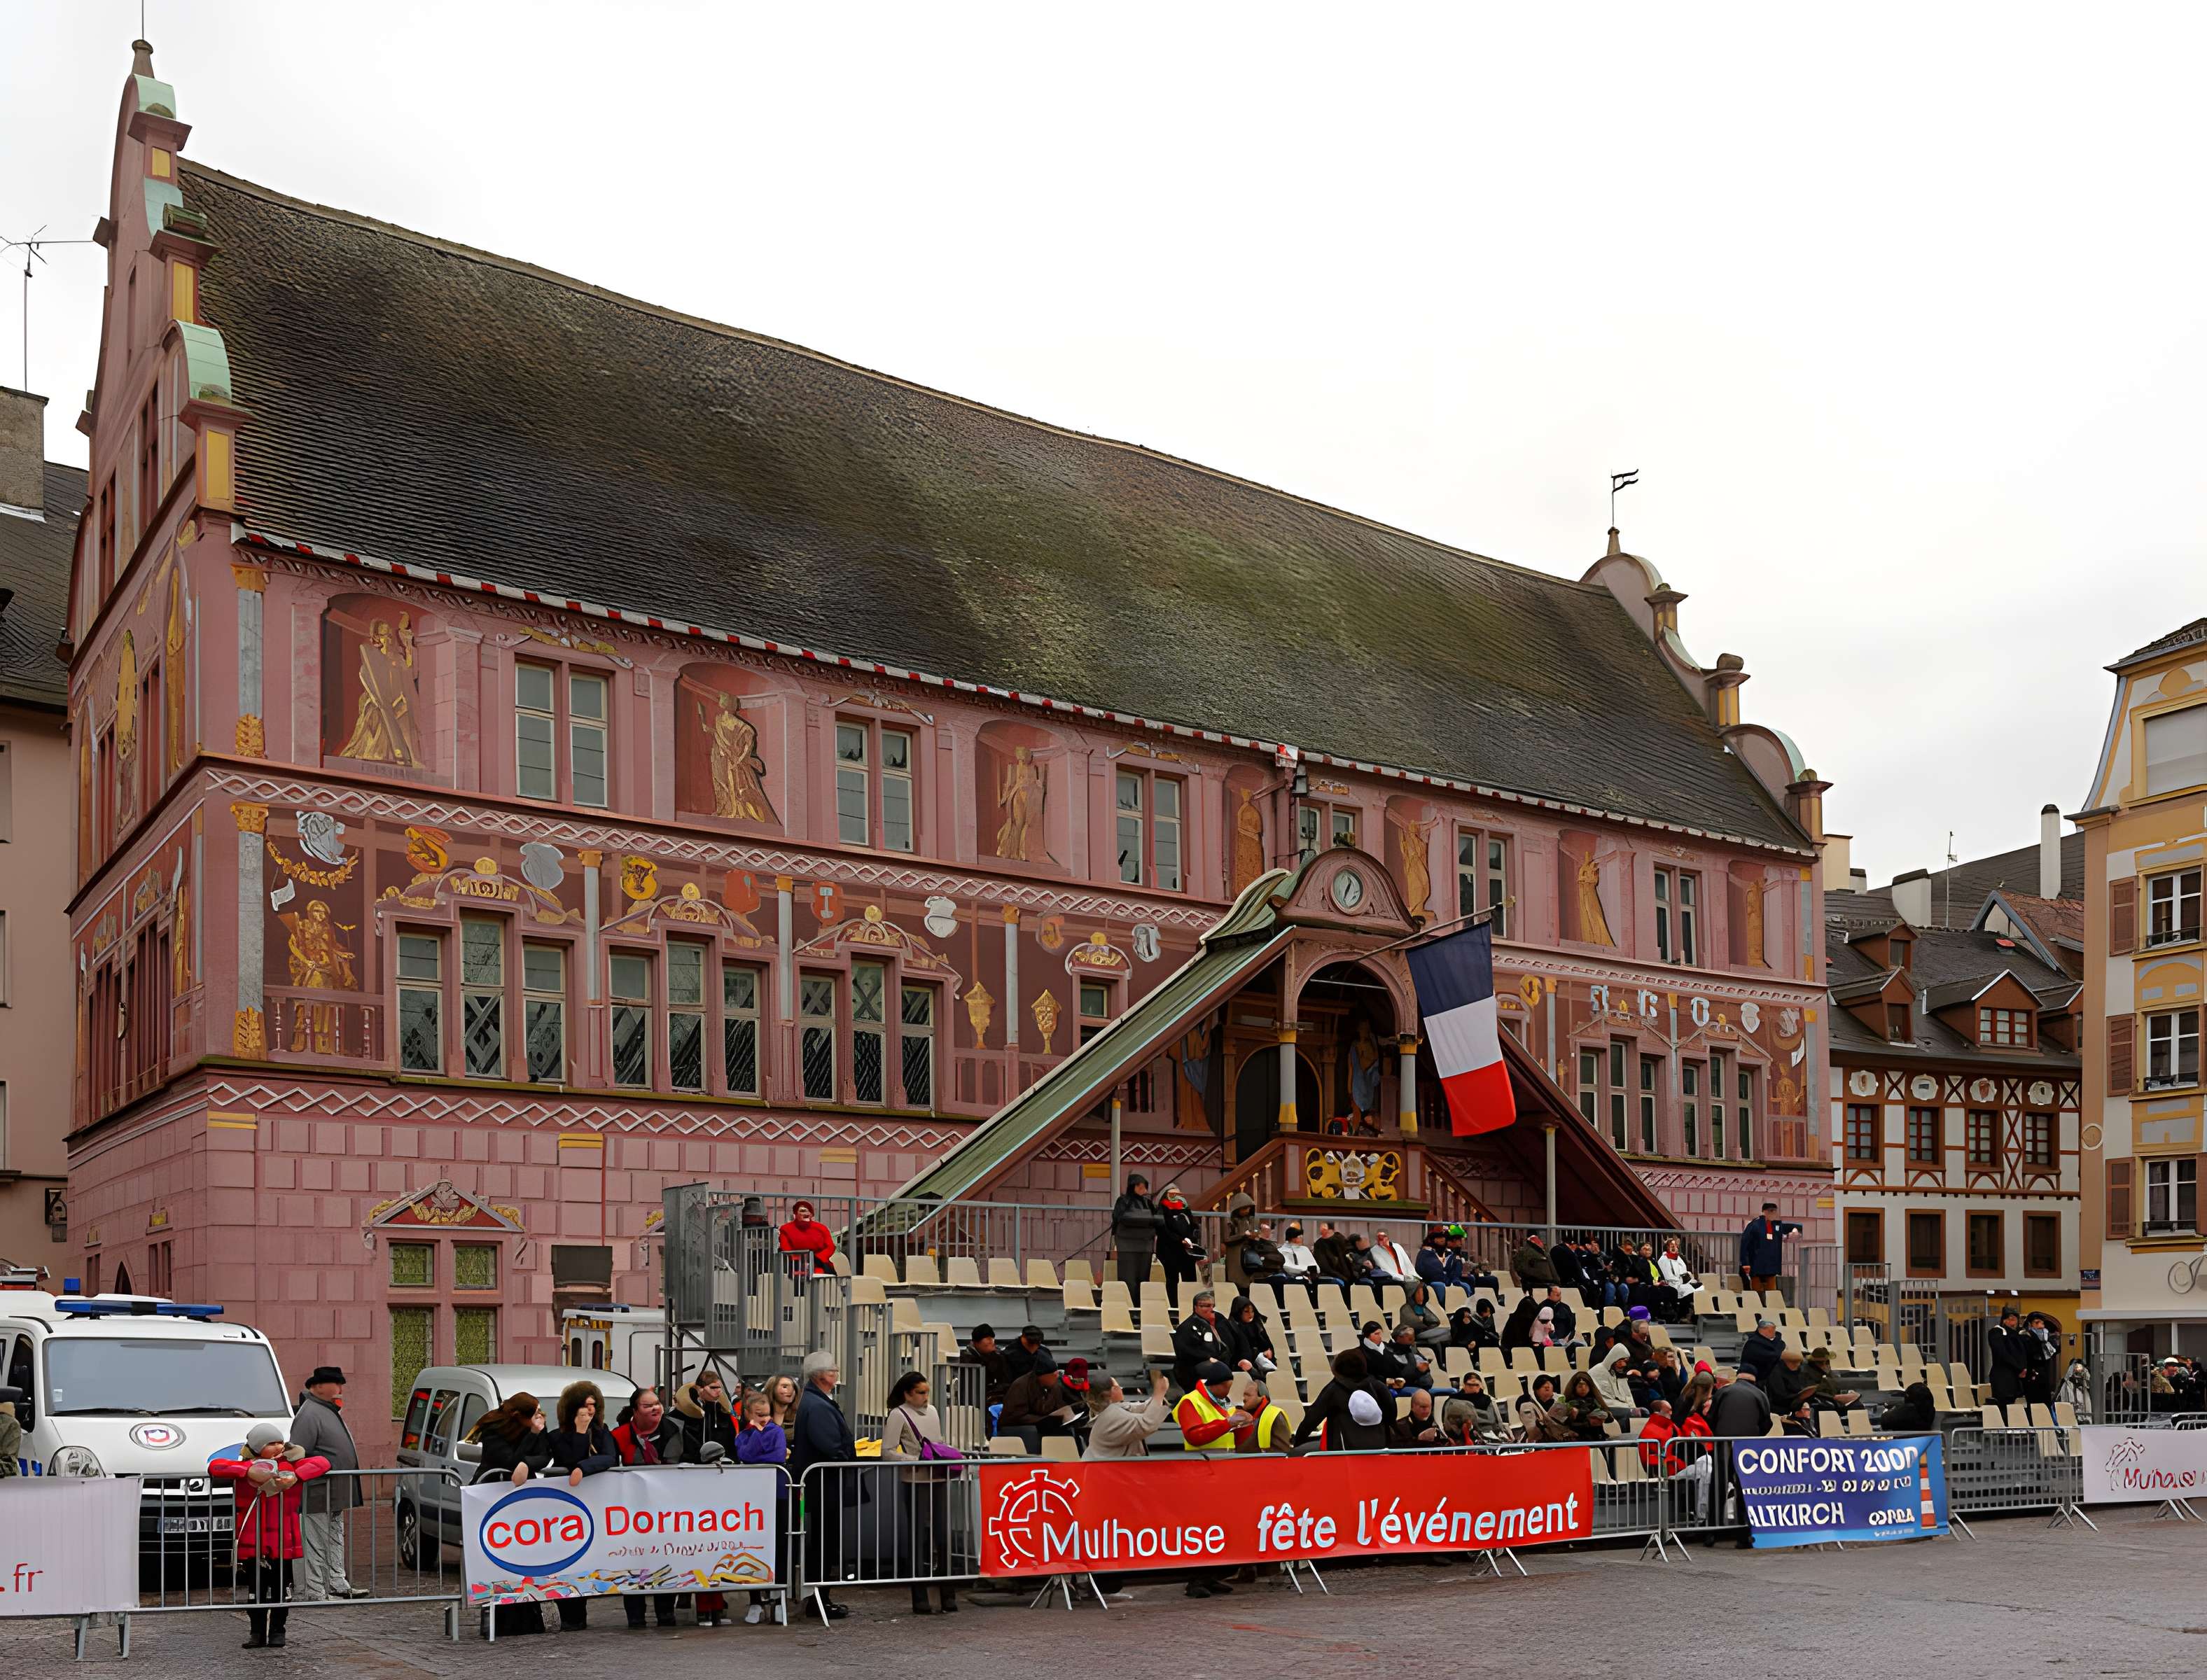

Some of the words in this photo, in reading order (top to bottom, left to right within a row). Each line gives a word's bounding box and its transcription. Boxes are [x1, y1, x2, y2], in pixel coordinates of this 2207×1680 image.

[1738, 1447, 1856, 1474] CONFORT
[486, 1513, 585, 1549] cora
[604, 1502, 765, 1536] Dornach
[1043, 1518, 1225, 1562] Mulhouse
[1257, 1502, 1337, 1552] fête
[1357, 1492, 1579, 1546] l'événement
[1748, 1501, 1846, 1527] ALTKIRCH
